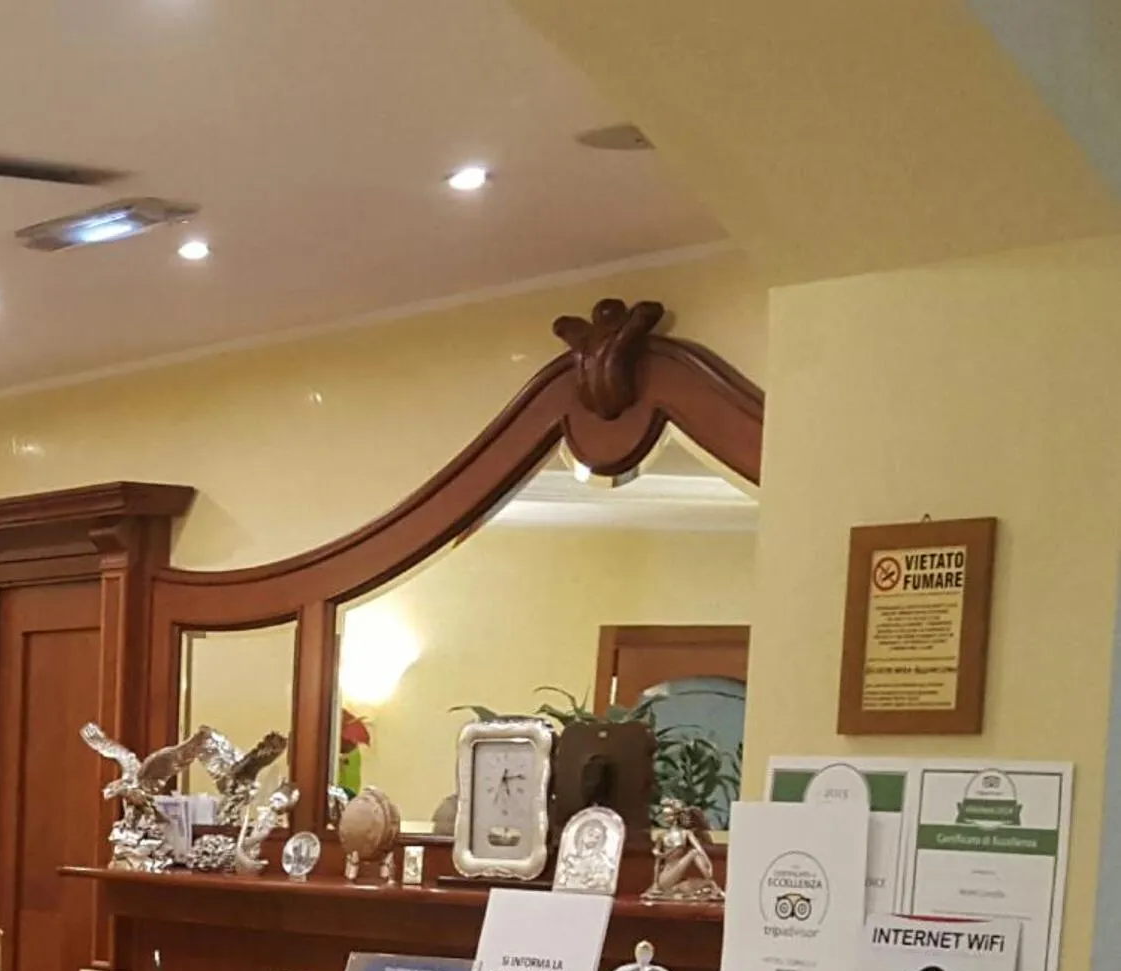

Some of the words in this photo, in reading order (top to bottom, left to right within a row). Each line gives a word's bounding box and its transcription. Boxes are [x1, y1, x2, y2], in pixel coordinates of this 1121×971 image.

[905, 551, 964, 570] VIETATO
[903, 571, 963, 590] FUMARE
[768, 877, 823, 888] ECCELLENZA
[764, 925, 821, 938] tripadvisor
[872, 927, 963, 949] INTERNET
[967, 933, 1005, 952] WiFi
[502, 956, 510, 966] SI
[511, 956, 551, 968] INFORMA
[552, 959, 563, 969] LA
